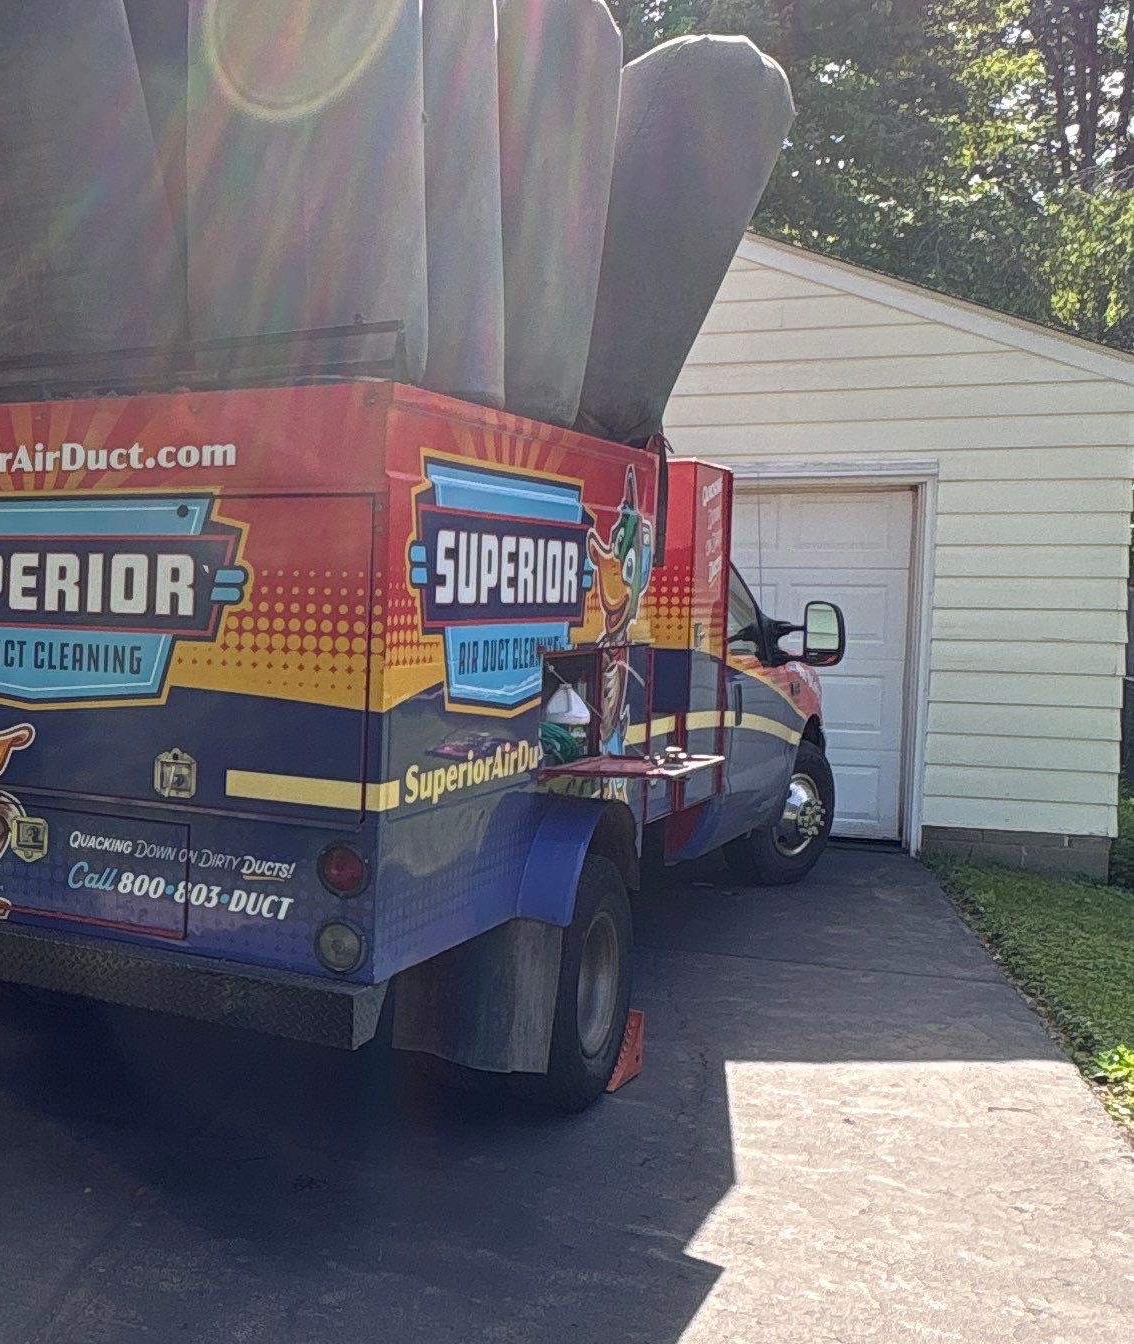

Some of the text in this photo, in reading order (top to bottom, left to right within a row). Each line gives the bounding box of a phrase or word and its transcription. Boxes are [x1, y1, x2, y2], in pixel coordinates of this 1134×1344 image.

[436, 529, 579, 604] SUPERIOR
[33, 641, 142, 675] CLEANING
[458, 640, 480, 676] AIR
[481, 638, 511, 673] DUCT
[69, 830, 296, 879] QUACKING DOWN ON DIRTY DUCTS!
[67, 861, 118, 892] Call
